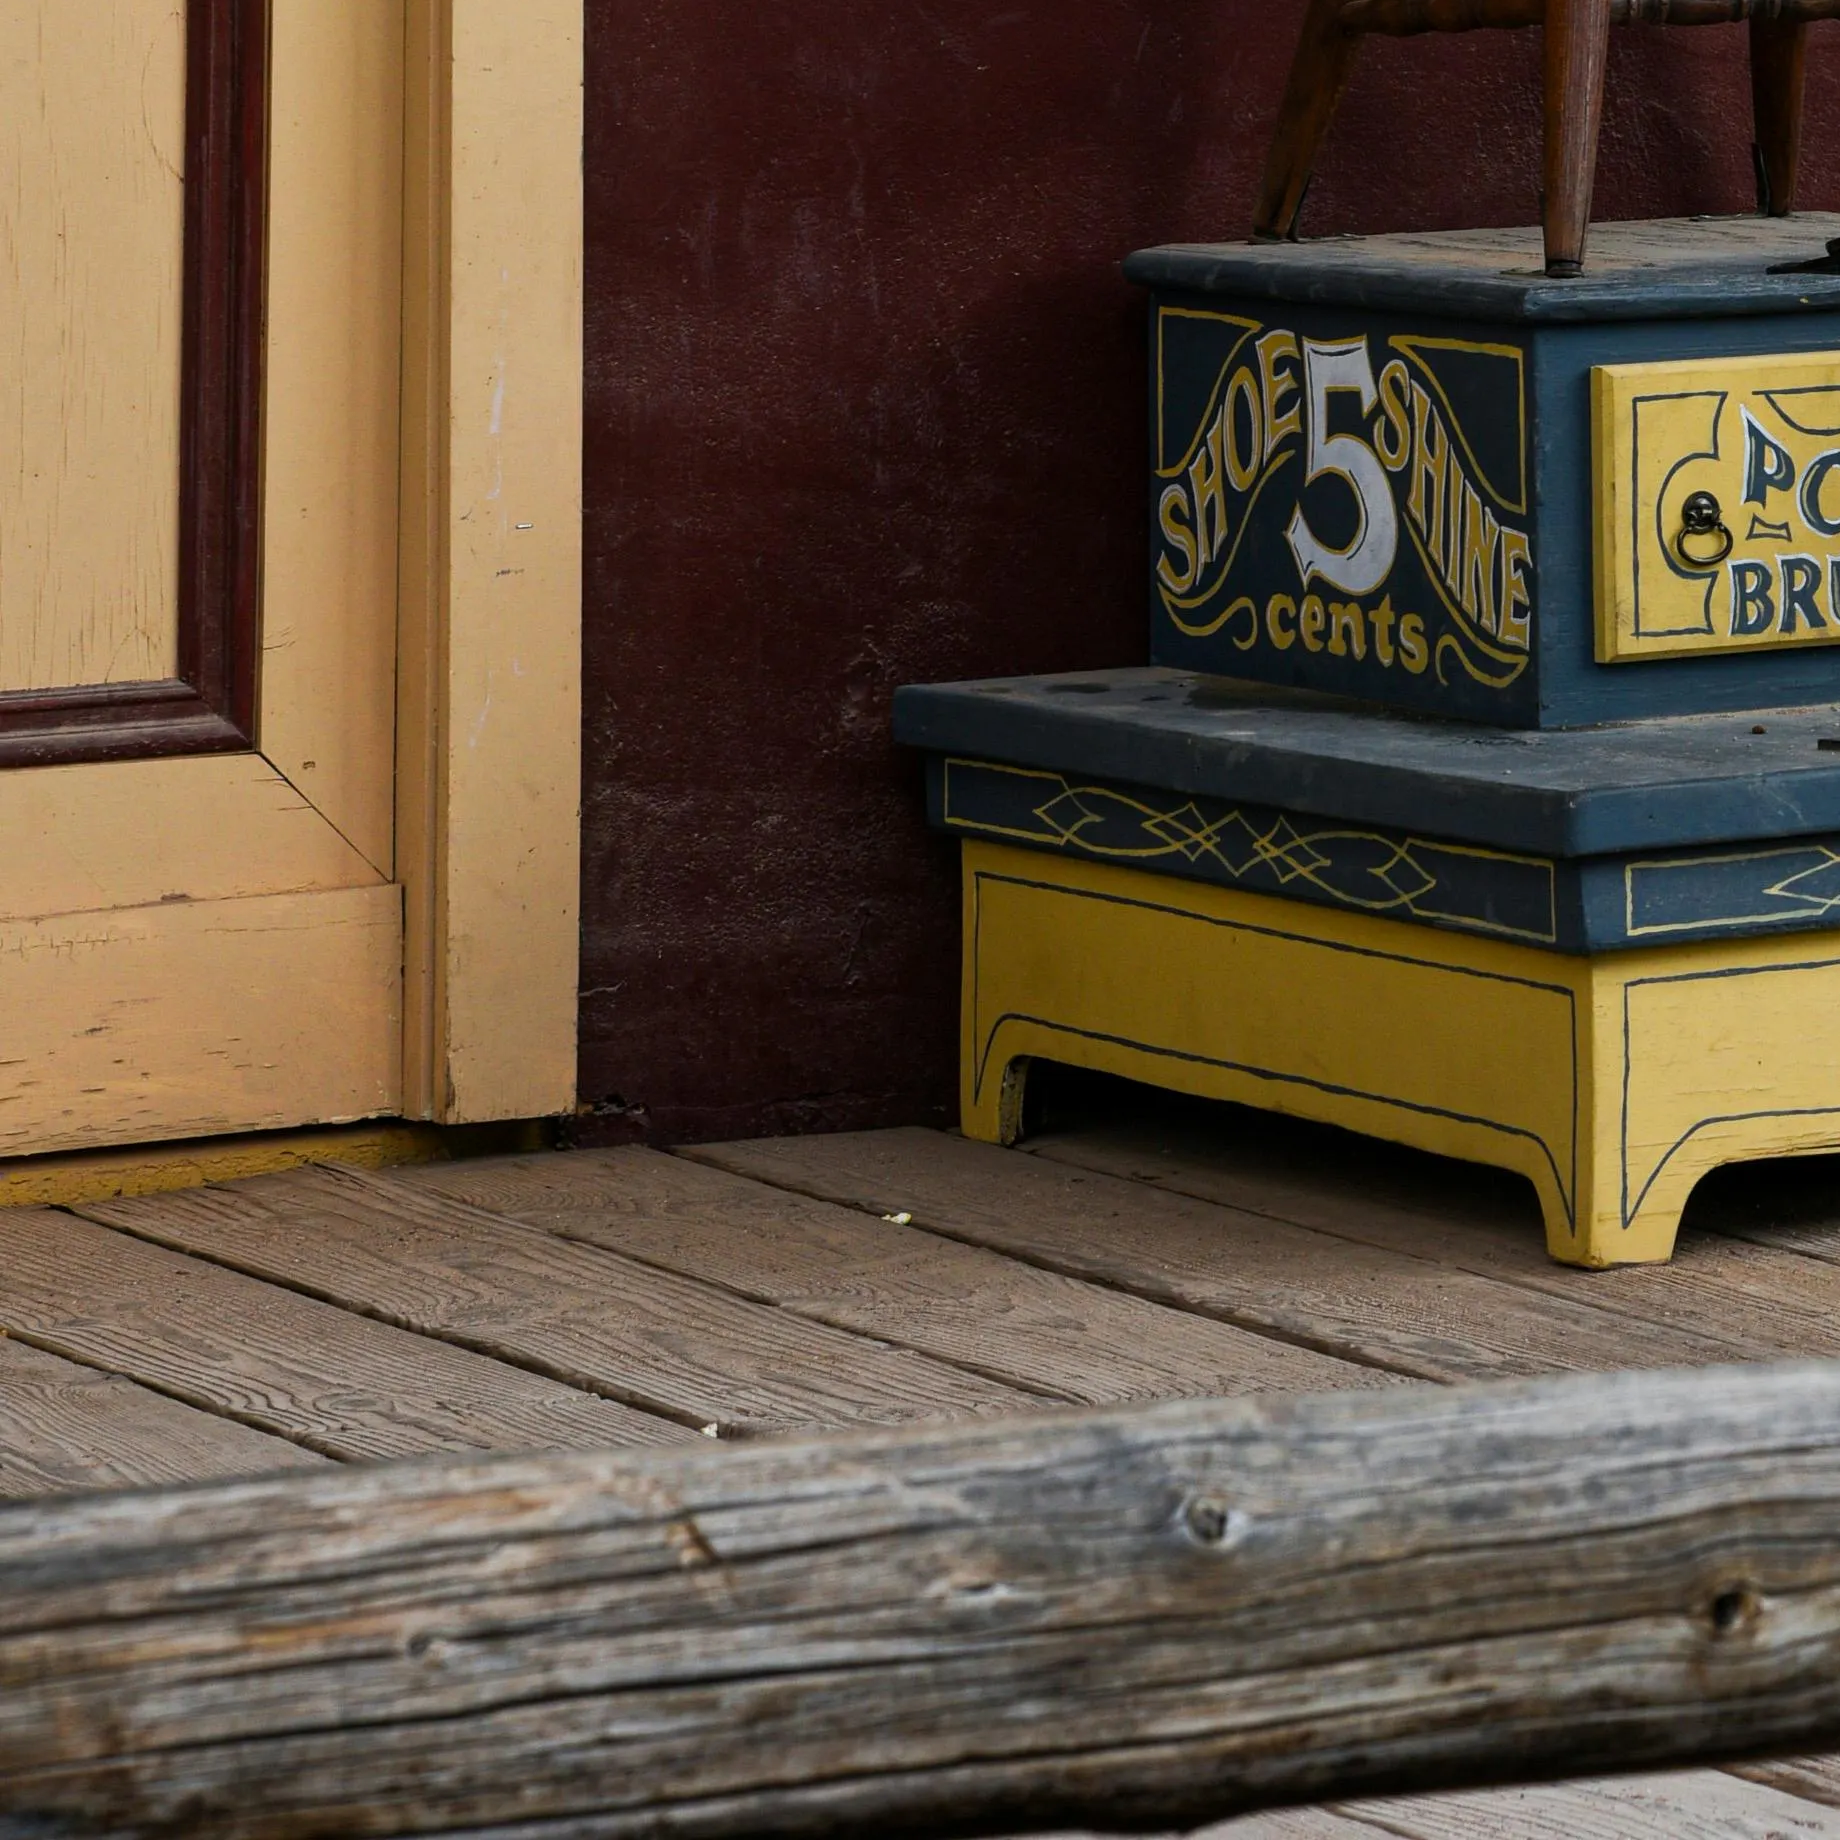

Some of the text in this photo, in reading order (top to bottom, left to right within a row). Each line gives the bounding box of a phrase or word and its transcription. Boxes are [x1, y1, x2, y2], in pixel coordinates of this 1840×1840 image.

[1156, 329, 1533, 652] SHOE 5 SHINE
[1265, 592, 1430, 675] cents
